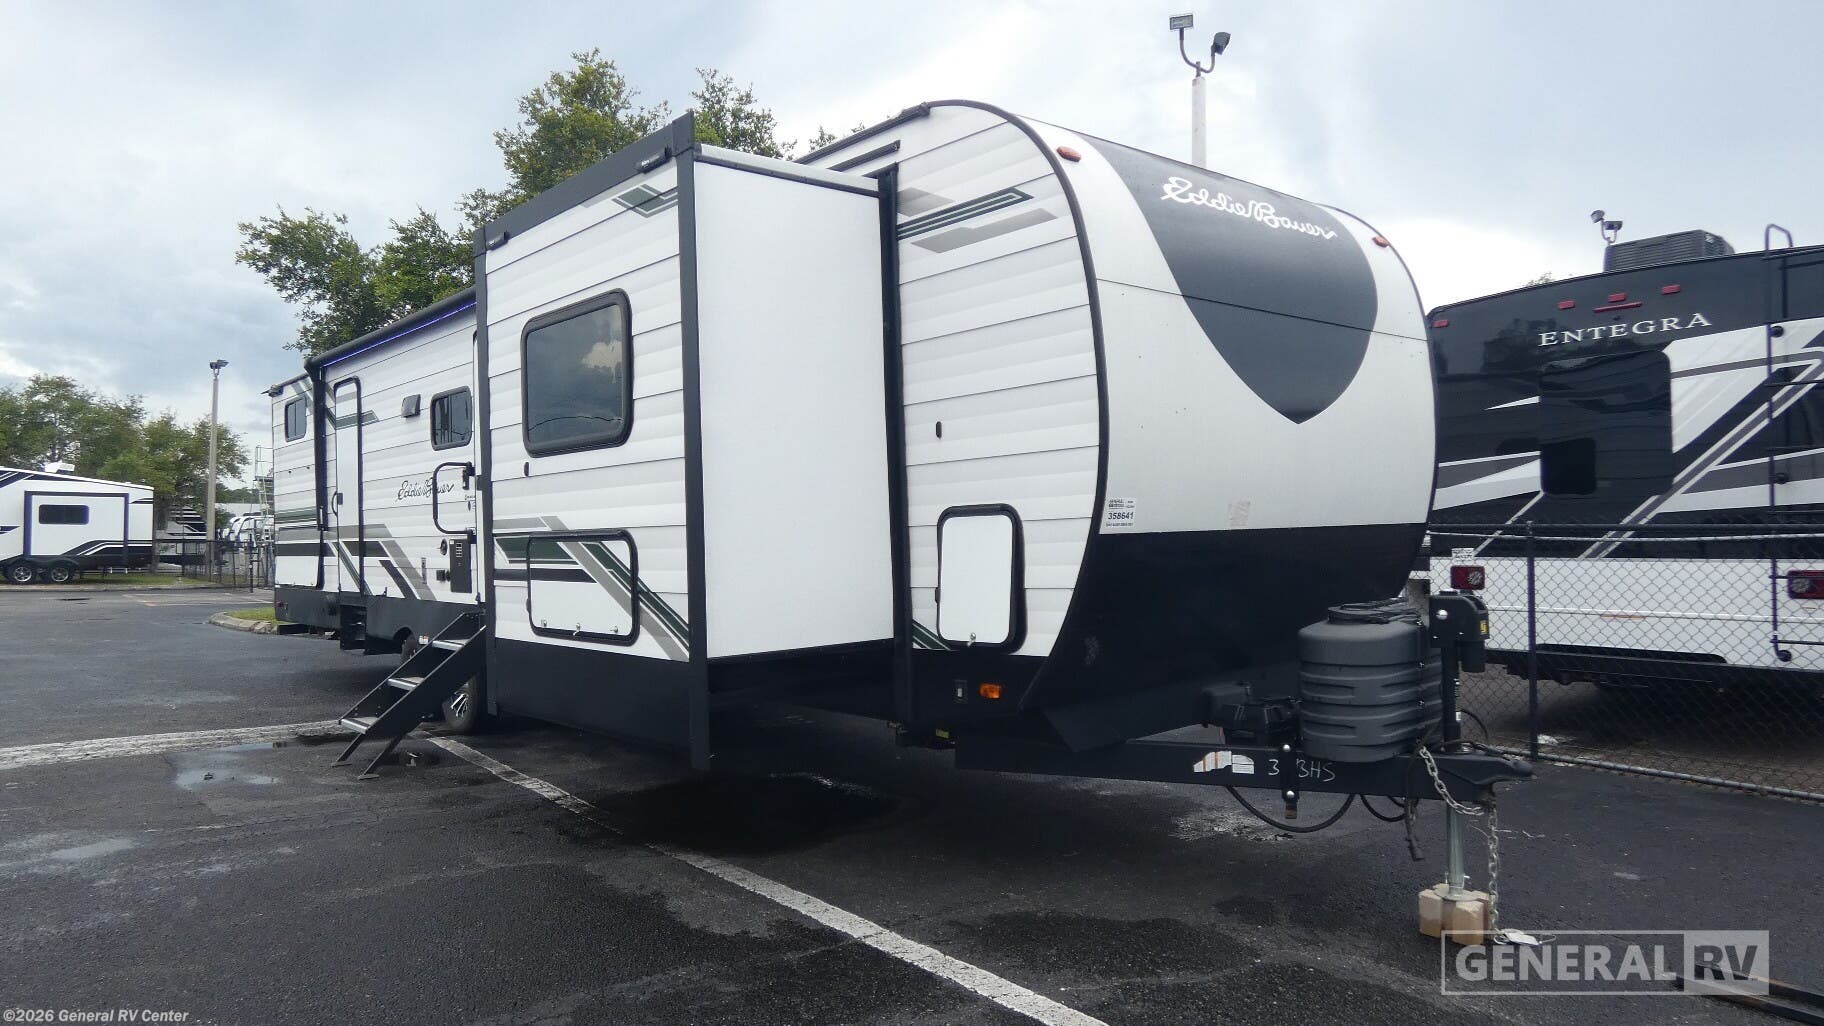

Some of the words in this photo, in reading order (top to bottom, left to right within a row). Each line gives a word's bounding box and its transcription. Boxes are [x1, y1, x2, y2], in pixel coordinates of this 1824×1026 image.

[1161, 177, 1251, 217] Eddie
[1249, 200, 1338, 240] Bauer
[1537, 312, 1713, 347] ENTEGRA
[1108, 512, 1134, 520] 358641
